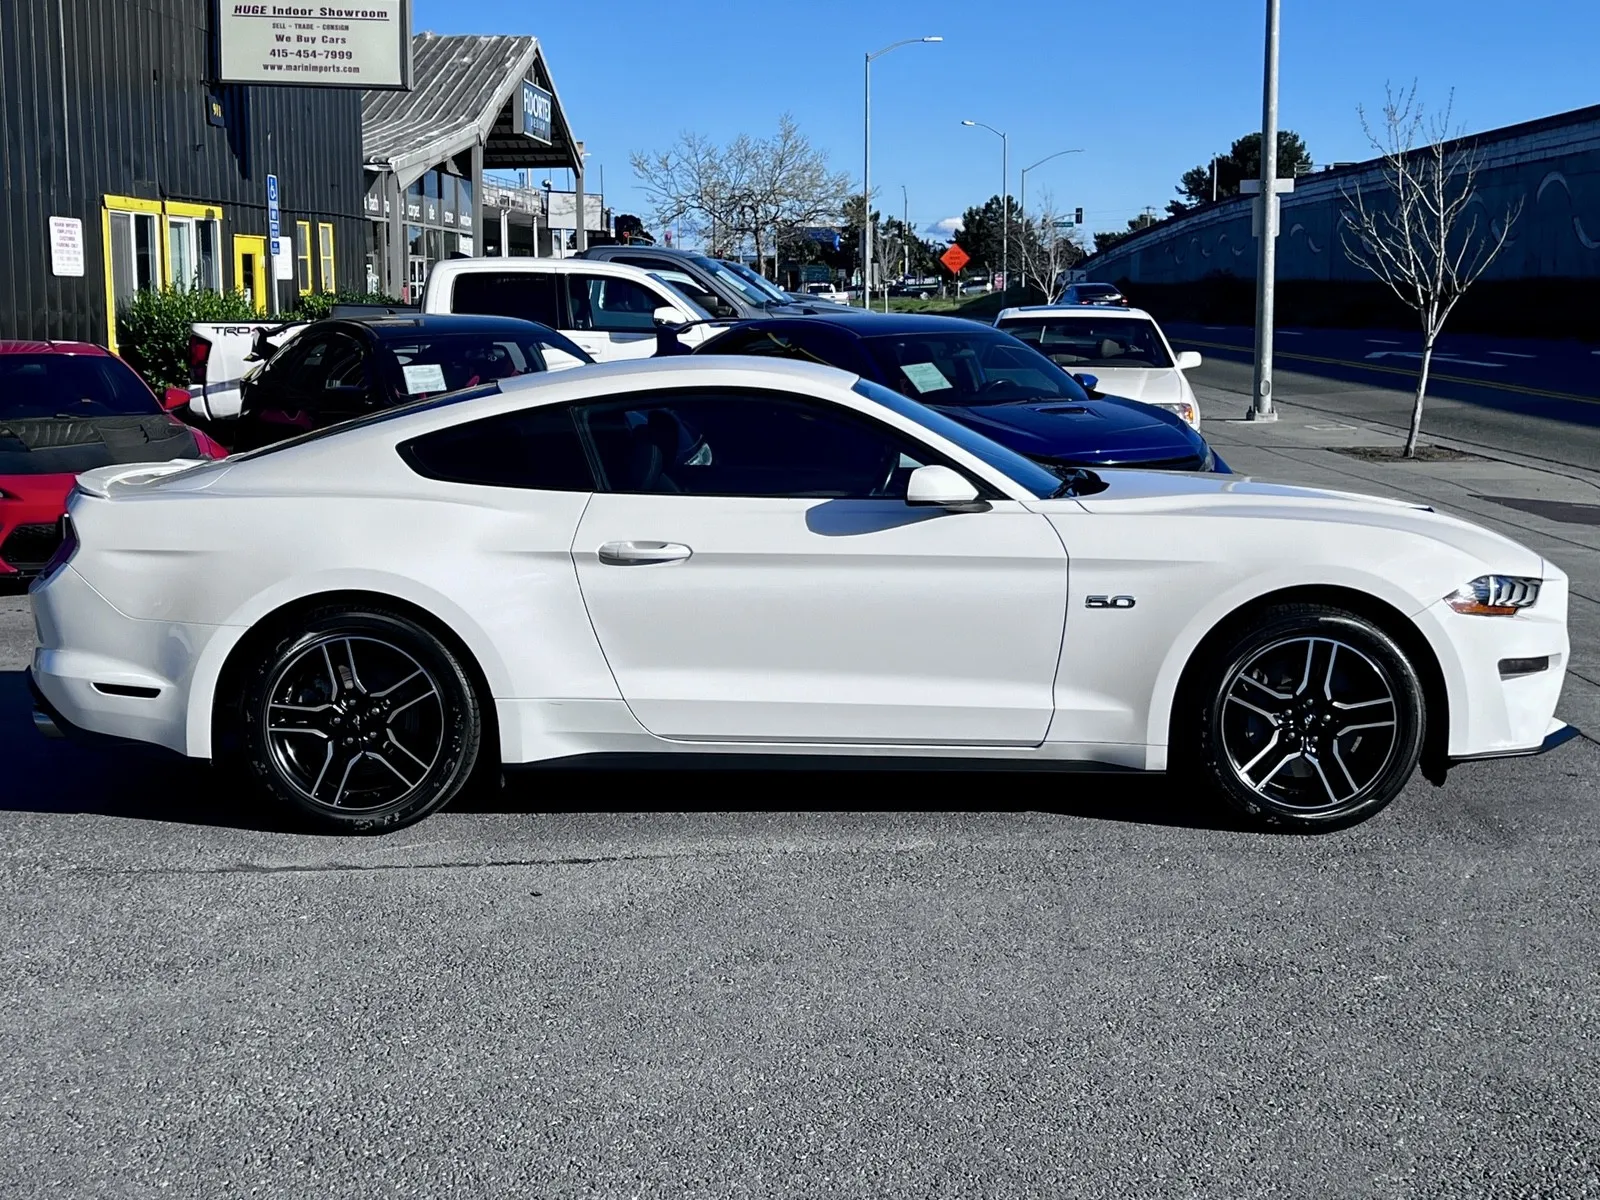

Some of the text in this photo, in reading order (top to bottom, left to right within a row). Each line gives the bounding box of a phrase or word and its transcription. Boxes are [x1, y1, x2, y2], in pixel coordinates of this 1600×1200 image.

[234, 5, 388, 18] HUGE Indoor Showroom
[275, 34, 346, 45] We Buy Cars
[269, 49, 353, 60] 415-454-7999
[262, 63, 360, 74] www.marinimports.com
[1085, 594, 1136, 609] 5.0
